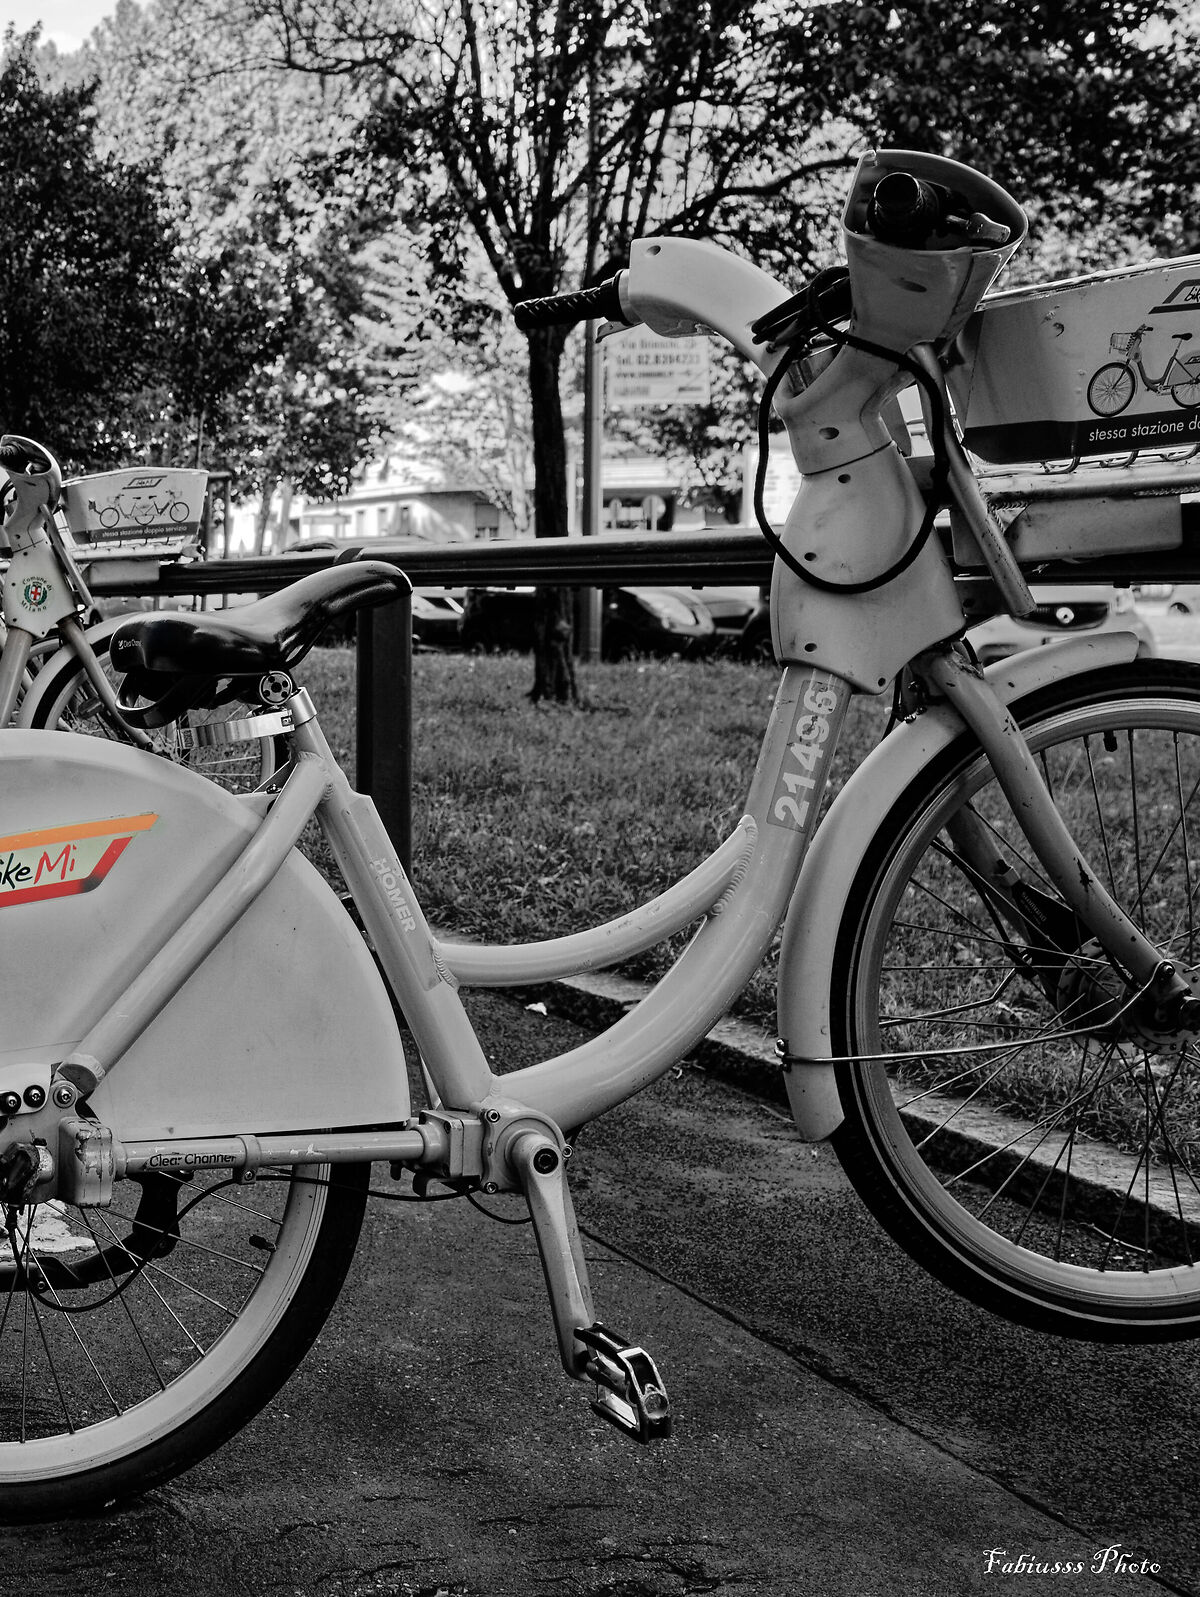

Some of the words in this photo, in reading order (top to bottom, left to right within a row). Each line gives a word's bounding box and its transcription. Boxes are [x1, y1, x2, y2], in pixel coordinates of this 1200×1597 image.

[1089, 428, 1127, 442] stessa
[1131, 420, 1185, 437] stazione
[143, 526, 165, 535] doppio
[22, 576, 47, 585] Comune
[21, 599, 47, 612] Milano
[774, 688, 838, 828] 21496
